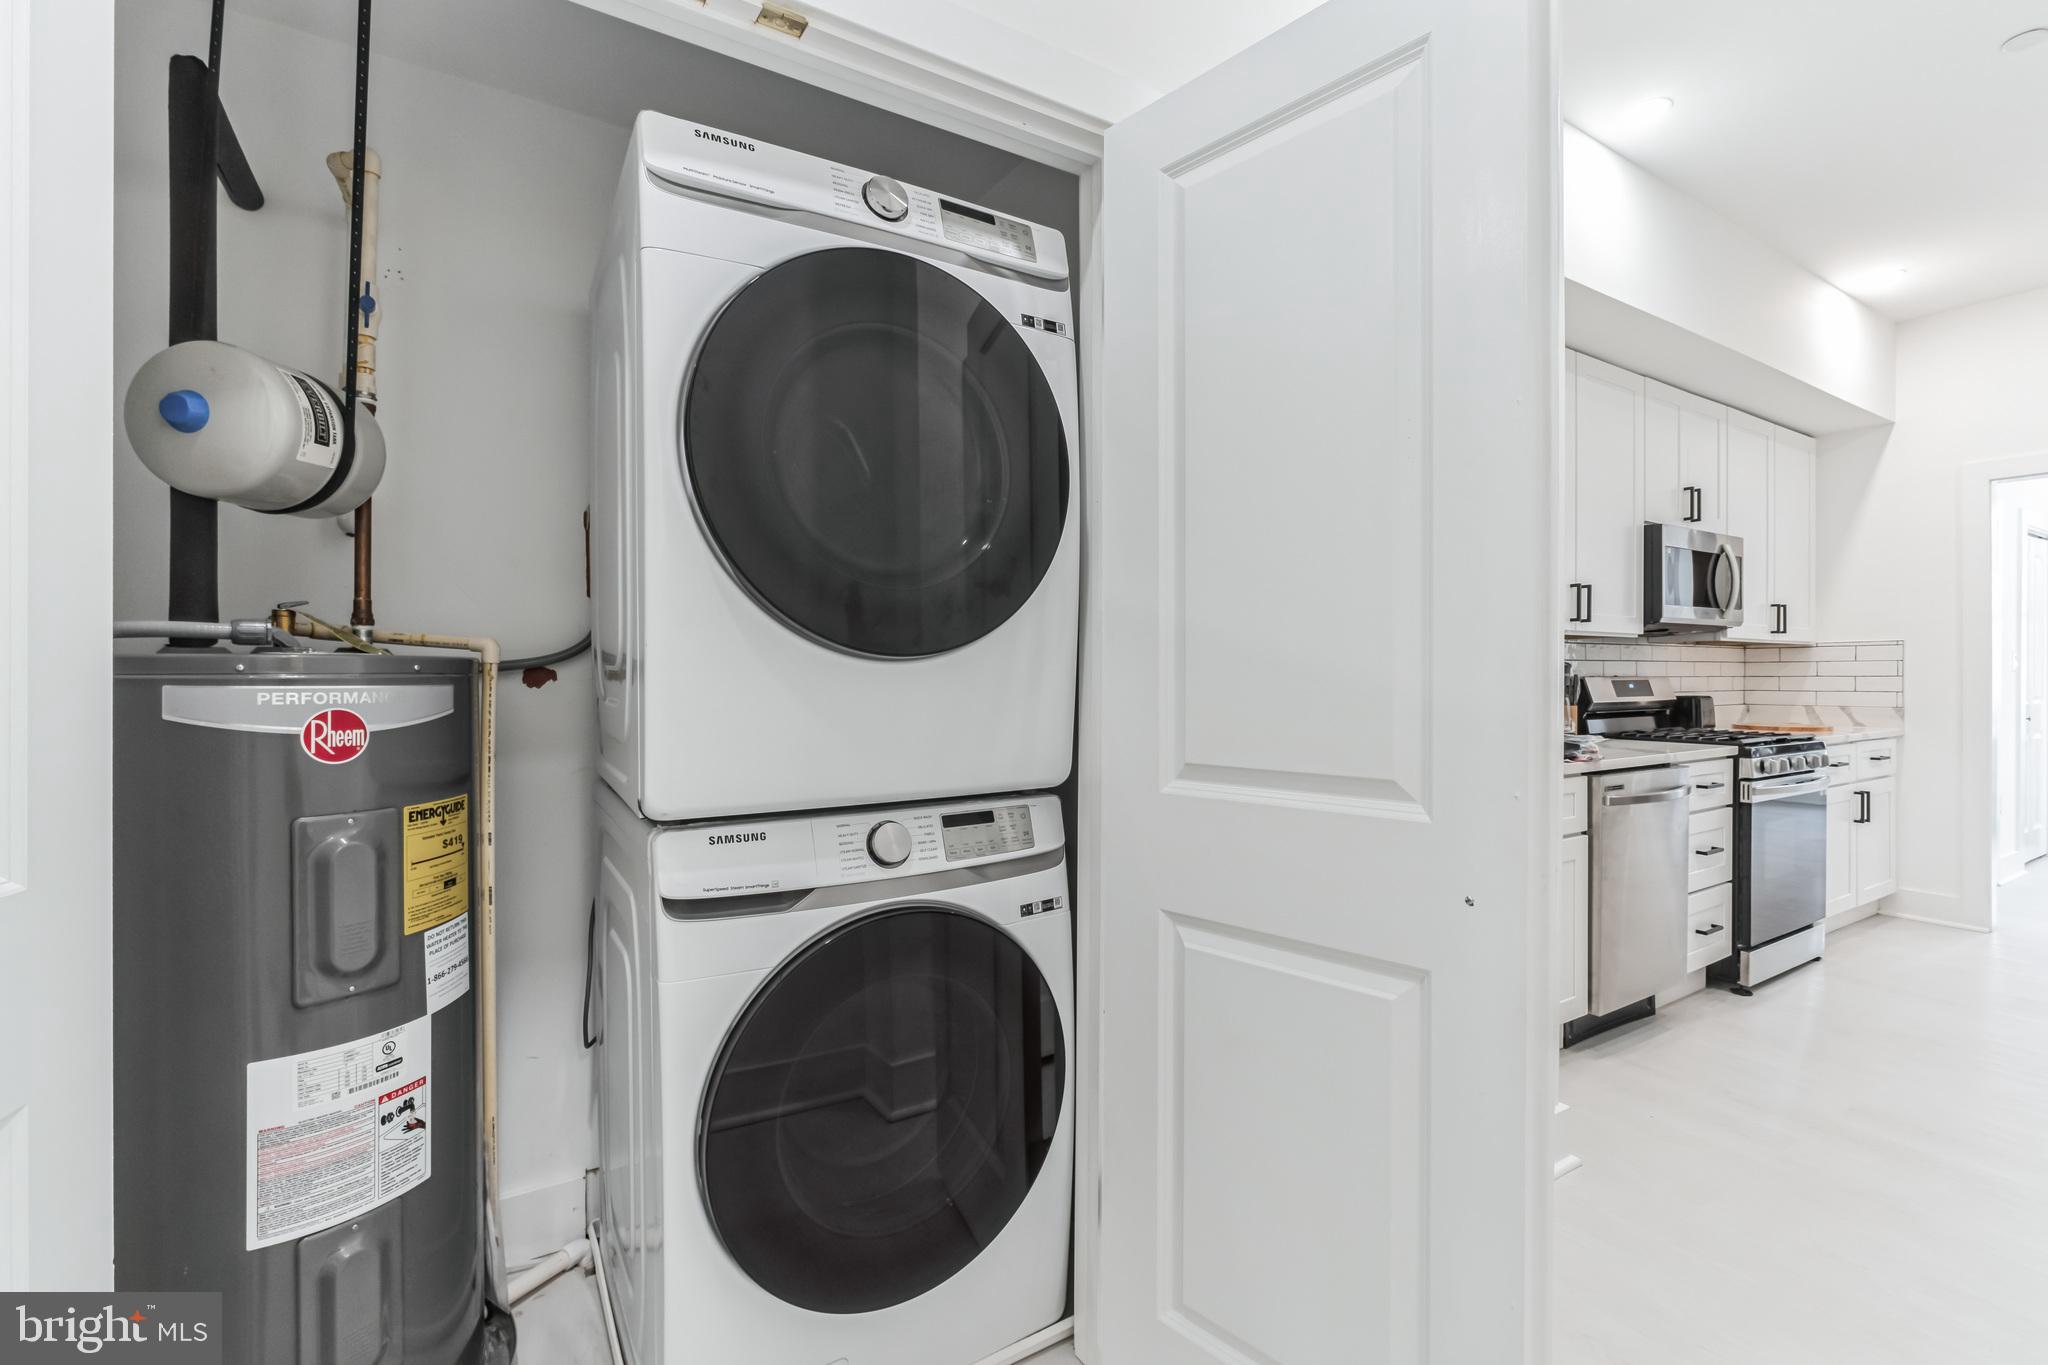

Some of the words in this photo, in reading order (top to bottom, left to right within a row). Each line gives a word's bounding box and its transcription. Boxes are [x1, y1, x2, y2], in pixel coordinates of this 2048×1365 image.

[694, 129, 756, 152] SAMSUNG
[310, 710, 365, 755] Rheem
[408, 799, 465, 825] ENERGYGUIDE
[708, 832, 767, 846] SAMSUNG
[427, 932, 435, 941] DO
[435, 928, 445, 940] NOT
[428, 945, 443, 956] PLACE
[391, 1078, 426, 1099] DANGER
